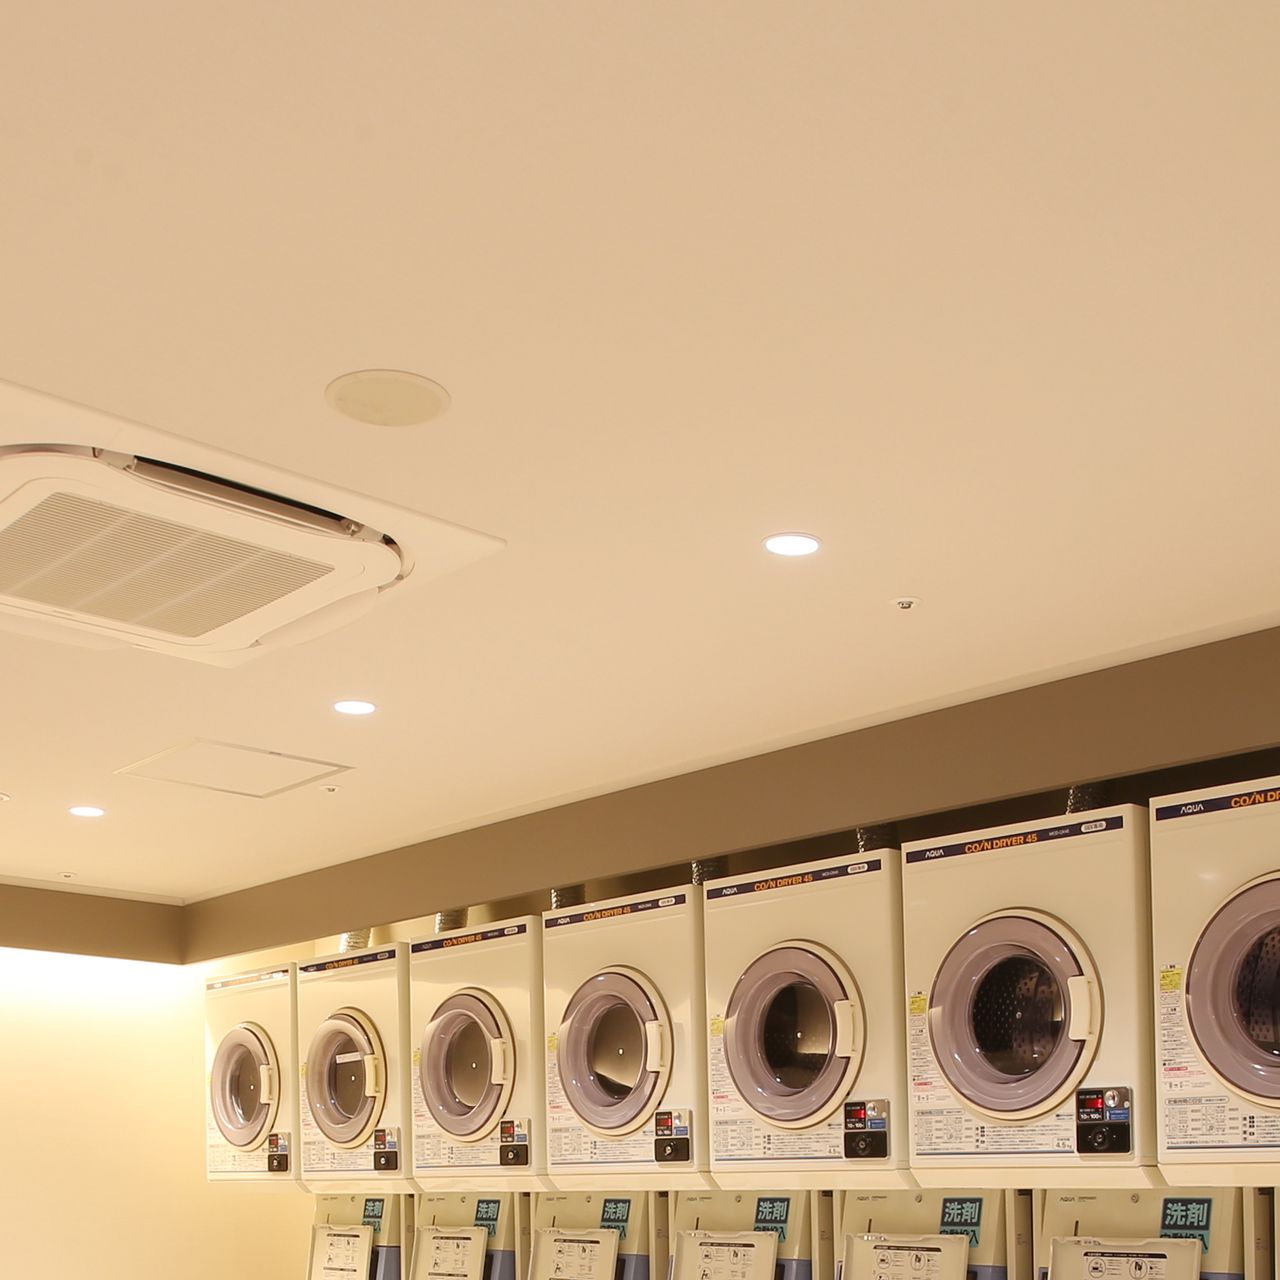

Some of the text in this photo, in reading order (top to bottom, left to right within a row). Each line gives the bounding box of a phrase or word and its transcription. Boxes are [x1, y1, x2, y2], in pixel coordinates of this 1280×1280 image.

[1181, 804, 1204, 814] AQUA
[993, 835, 1024, 850] DRYER
[1026, 833, 1038, 843] 45
[925, 849, 944, 858] AQUA
[604, 1202, 629, 1219] 洗剤
[758, 1201, 788, 1220] 洗剤
[944, 1202, 979, 1223] 洗剤
[1164, 1202, 1207, 1226] 洗剤
